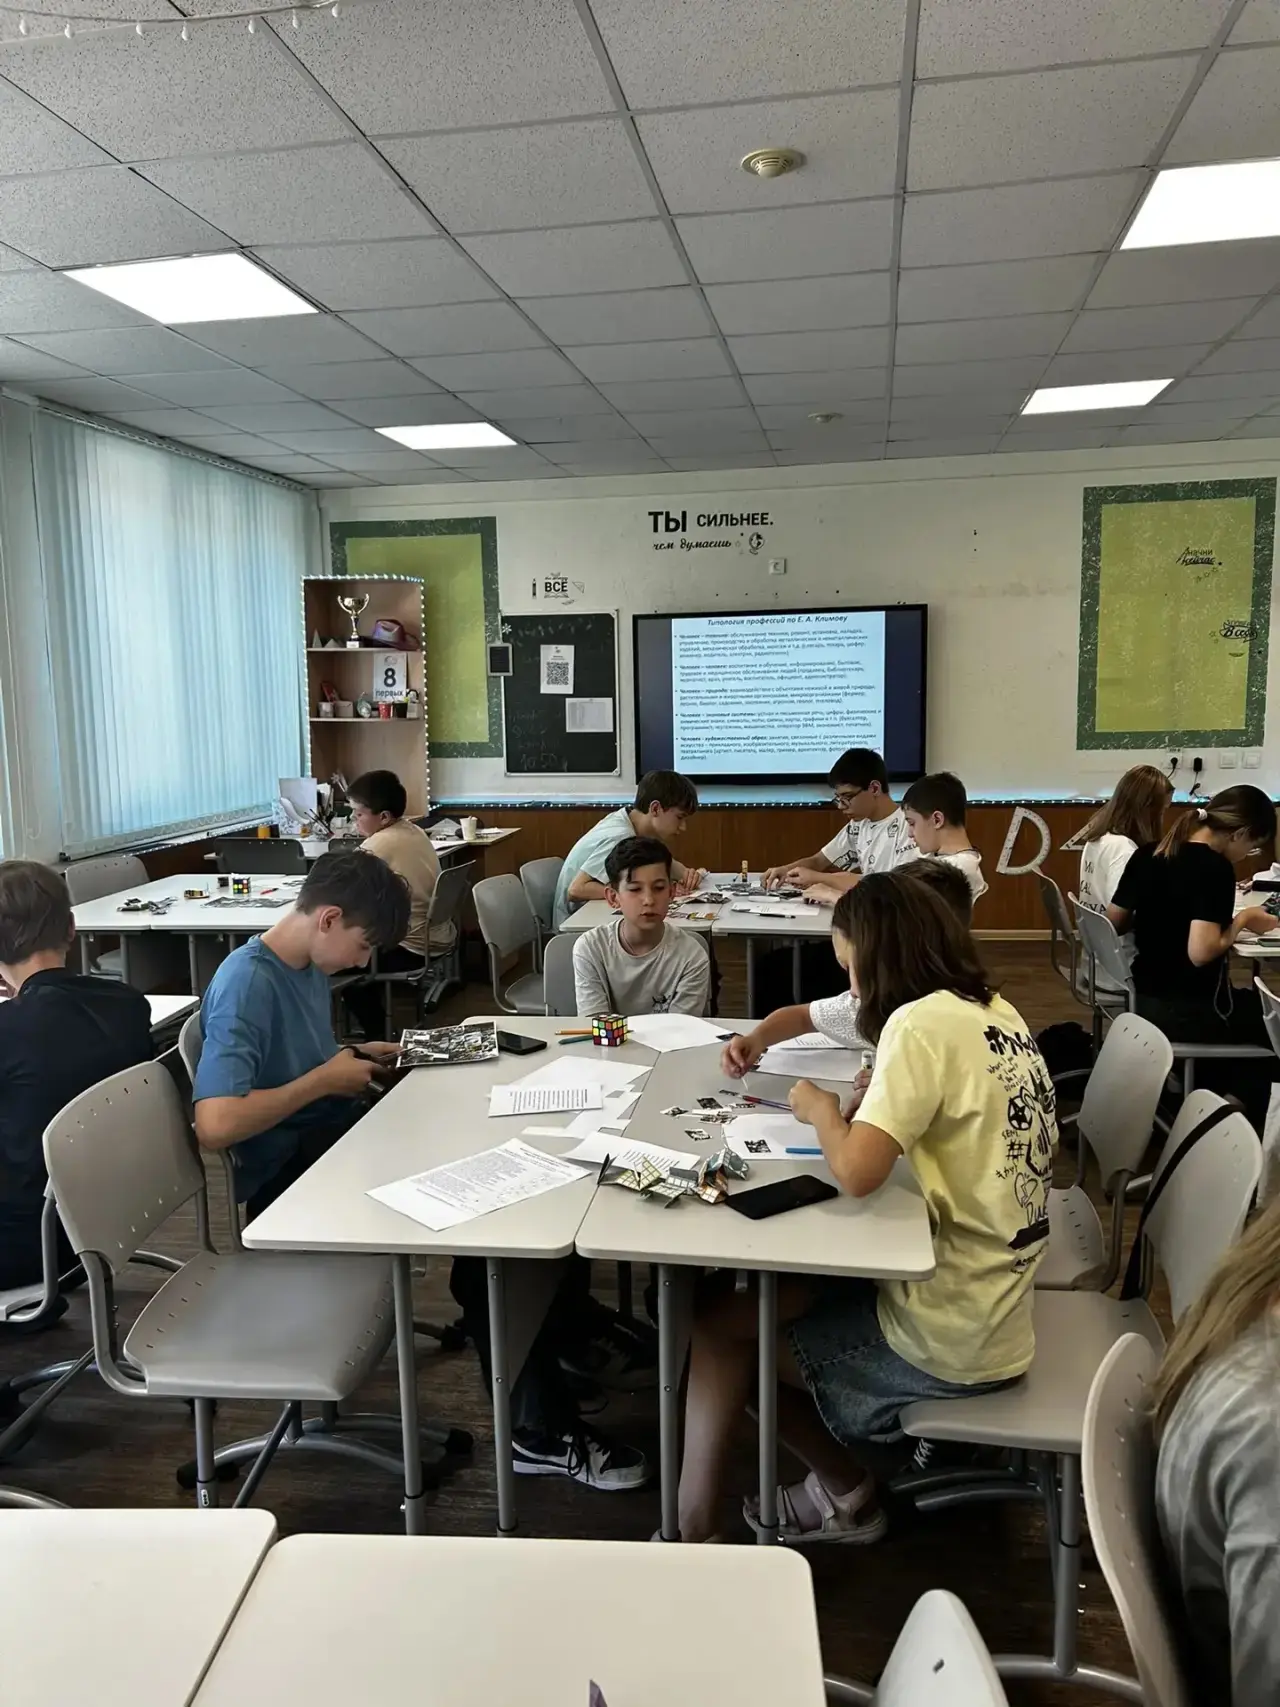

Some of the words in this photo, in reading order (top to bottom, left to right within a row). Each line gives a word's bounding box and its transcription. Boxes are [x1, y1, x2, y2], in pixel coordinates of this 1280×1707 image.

[648, 511, 687, 532] ТЫ
[696, 512, 774, 527] СИЛЬНЕЕ.
[653, 541, 674, 550] чем
[680, 538, 732, 551] думаешь
[746, 617, 785, 626] профессий
[805, 615, 813, 623] А.
[815, 615, 849, 623] Климову
[383, 667, 397, 688] 8
[375, 690, 404, 698] первых
